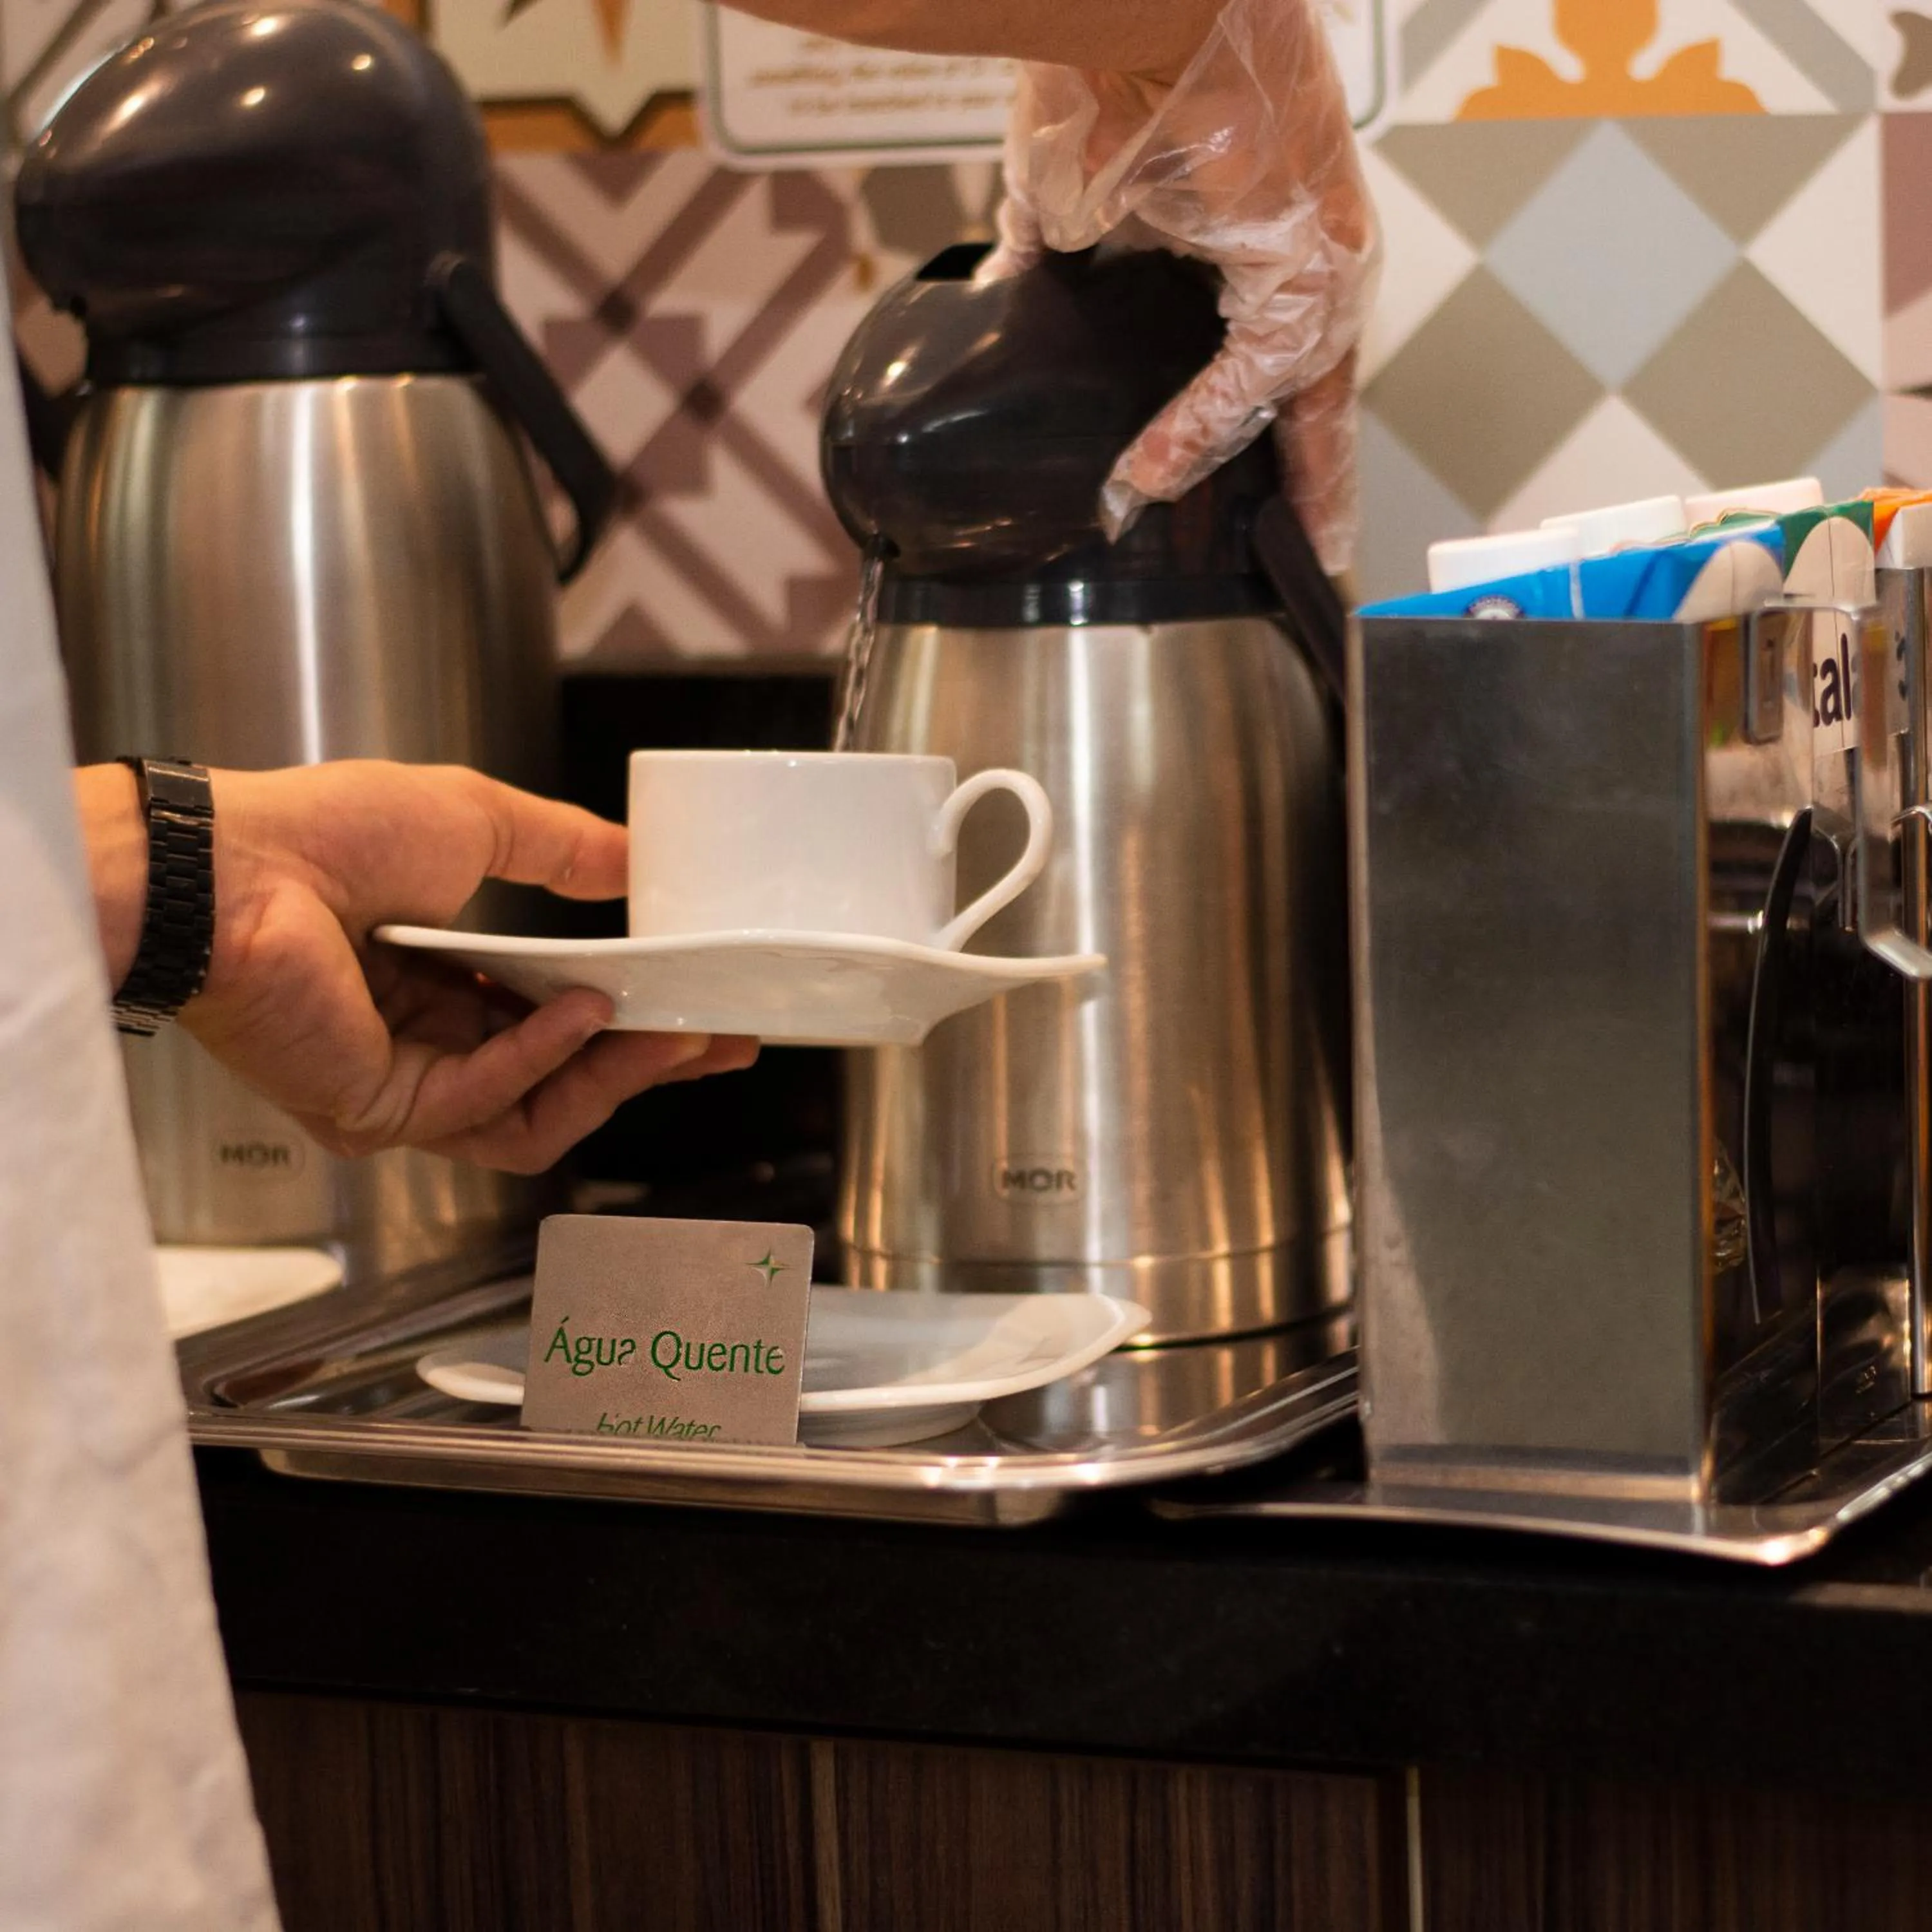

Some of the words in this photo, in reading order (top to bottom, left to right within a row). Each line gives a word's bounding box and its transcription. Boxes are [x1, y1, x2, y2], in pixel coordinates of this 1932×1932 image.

[220, 1142, 290, 1170] MOR
[1001, 1167, 1076, 1193] MOR
[544, 1316, 636, 1376] Água
[650, 1331, 785, 1381] Quente
